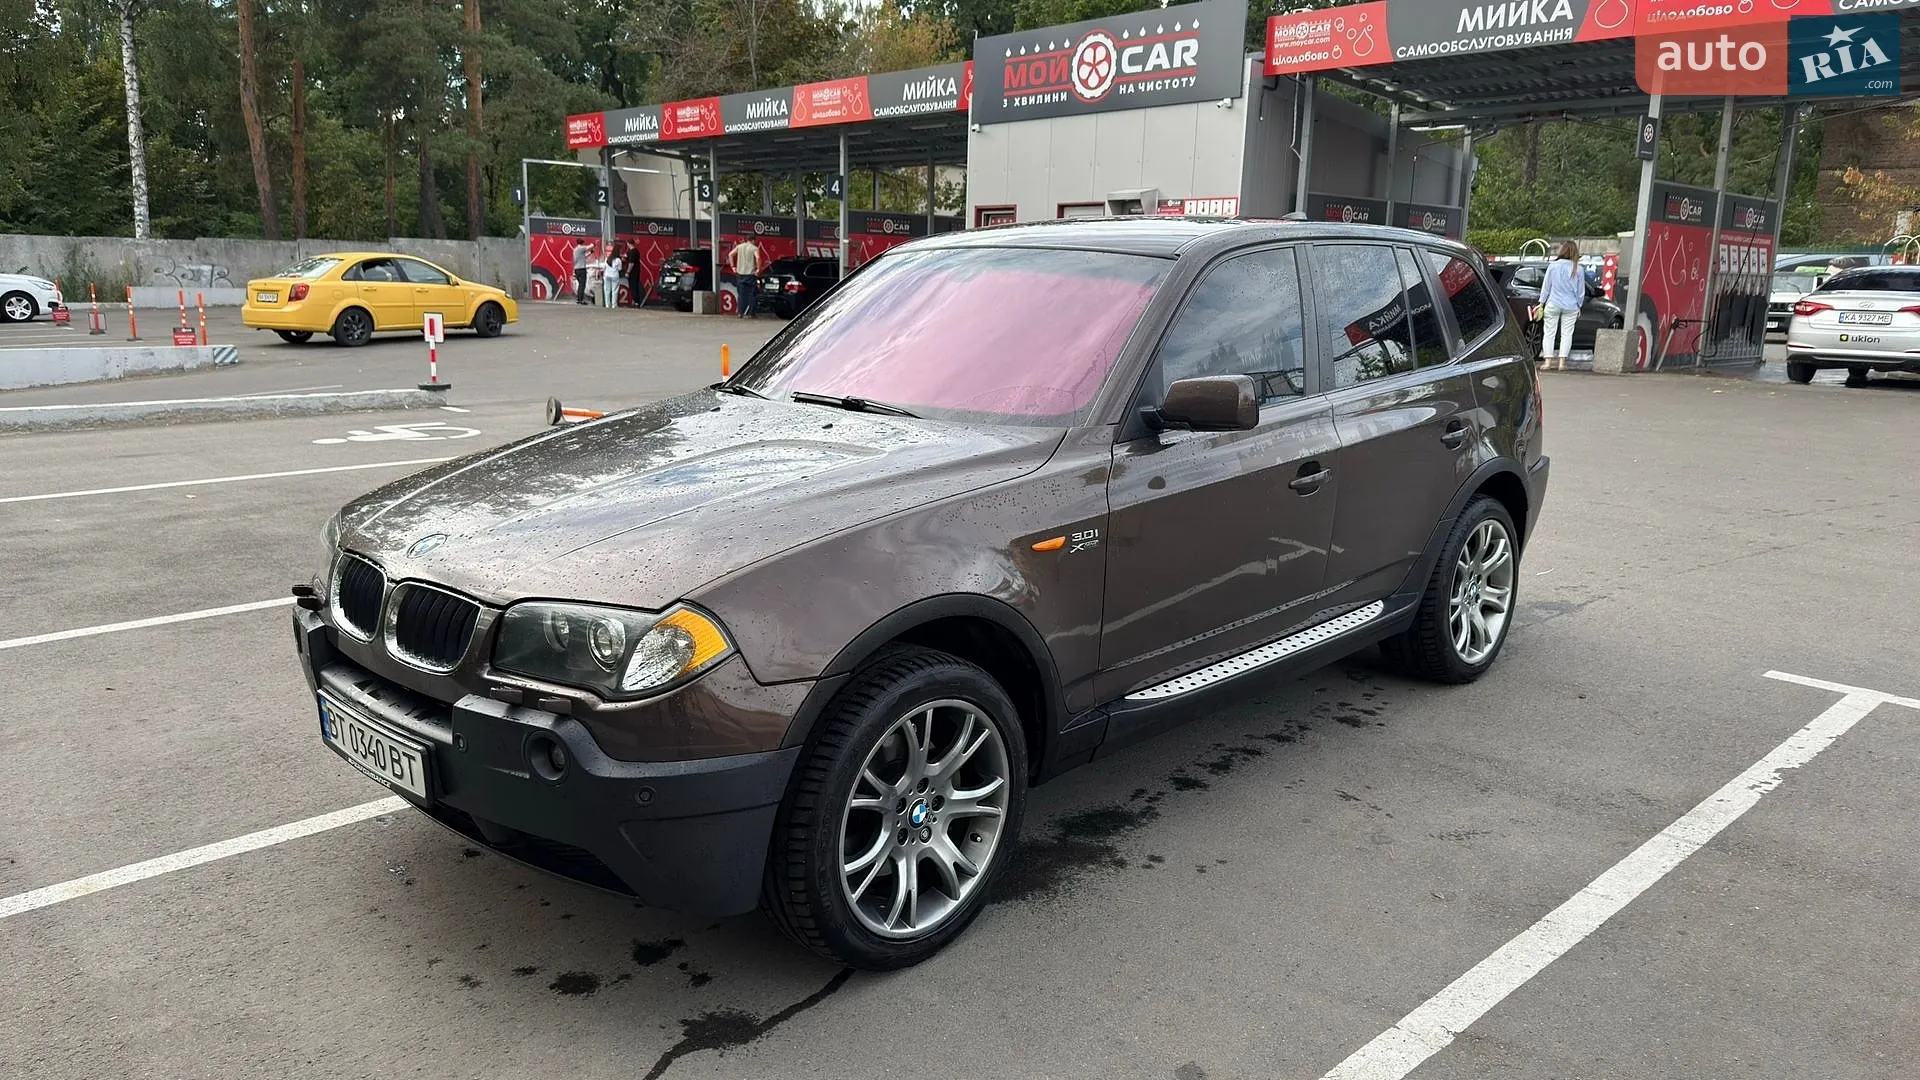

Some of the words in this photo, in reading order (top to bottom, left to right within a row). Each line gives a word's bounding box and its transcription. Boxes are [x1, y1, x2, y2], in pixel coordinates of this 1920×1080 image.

[1396, 27, 1574, 59] САМООБСЛУГОВУВАННЯ
[1121, 38, 1199, 74] CAR
[1272, 51, 1329, 66] цілодобово
[902, 75, 958, 101] МИЙКА
[1014, 91, 1067, 107] ХВИЛИНИ
[1119, 84, 1135, 95] НА
[1138, 76, 1197, 92] ЧИСТОТУ
[746, 97, 789, 119] МИЙКА
[873, 100, 957, 117] САМООБСЛУГОВУВАННЯ
[624, 114, 659, 133] МИЙКА
[724, 119, 789, 132] САМООБСЛУГОВУВАННЯ
[516, 189, 522, 201] 1
[702, 185, 710, 198] 3
[831, 180, 840, 195] 4
[598, 190, 606, 203] 2
[534, 284, 541, 297] 1
[619, 289, 628, 304] 2
[723, 294, 732, 311] 3
[1851, 334, 1881, 343] uklon
[327, 706, 346, 746] BT
[349, 722, 387, 771] 0340
[388, 744, 417, 787] BT
